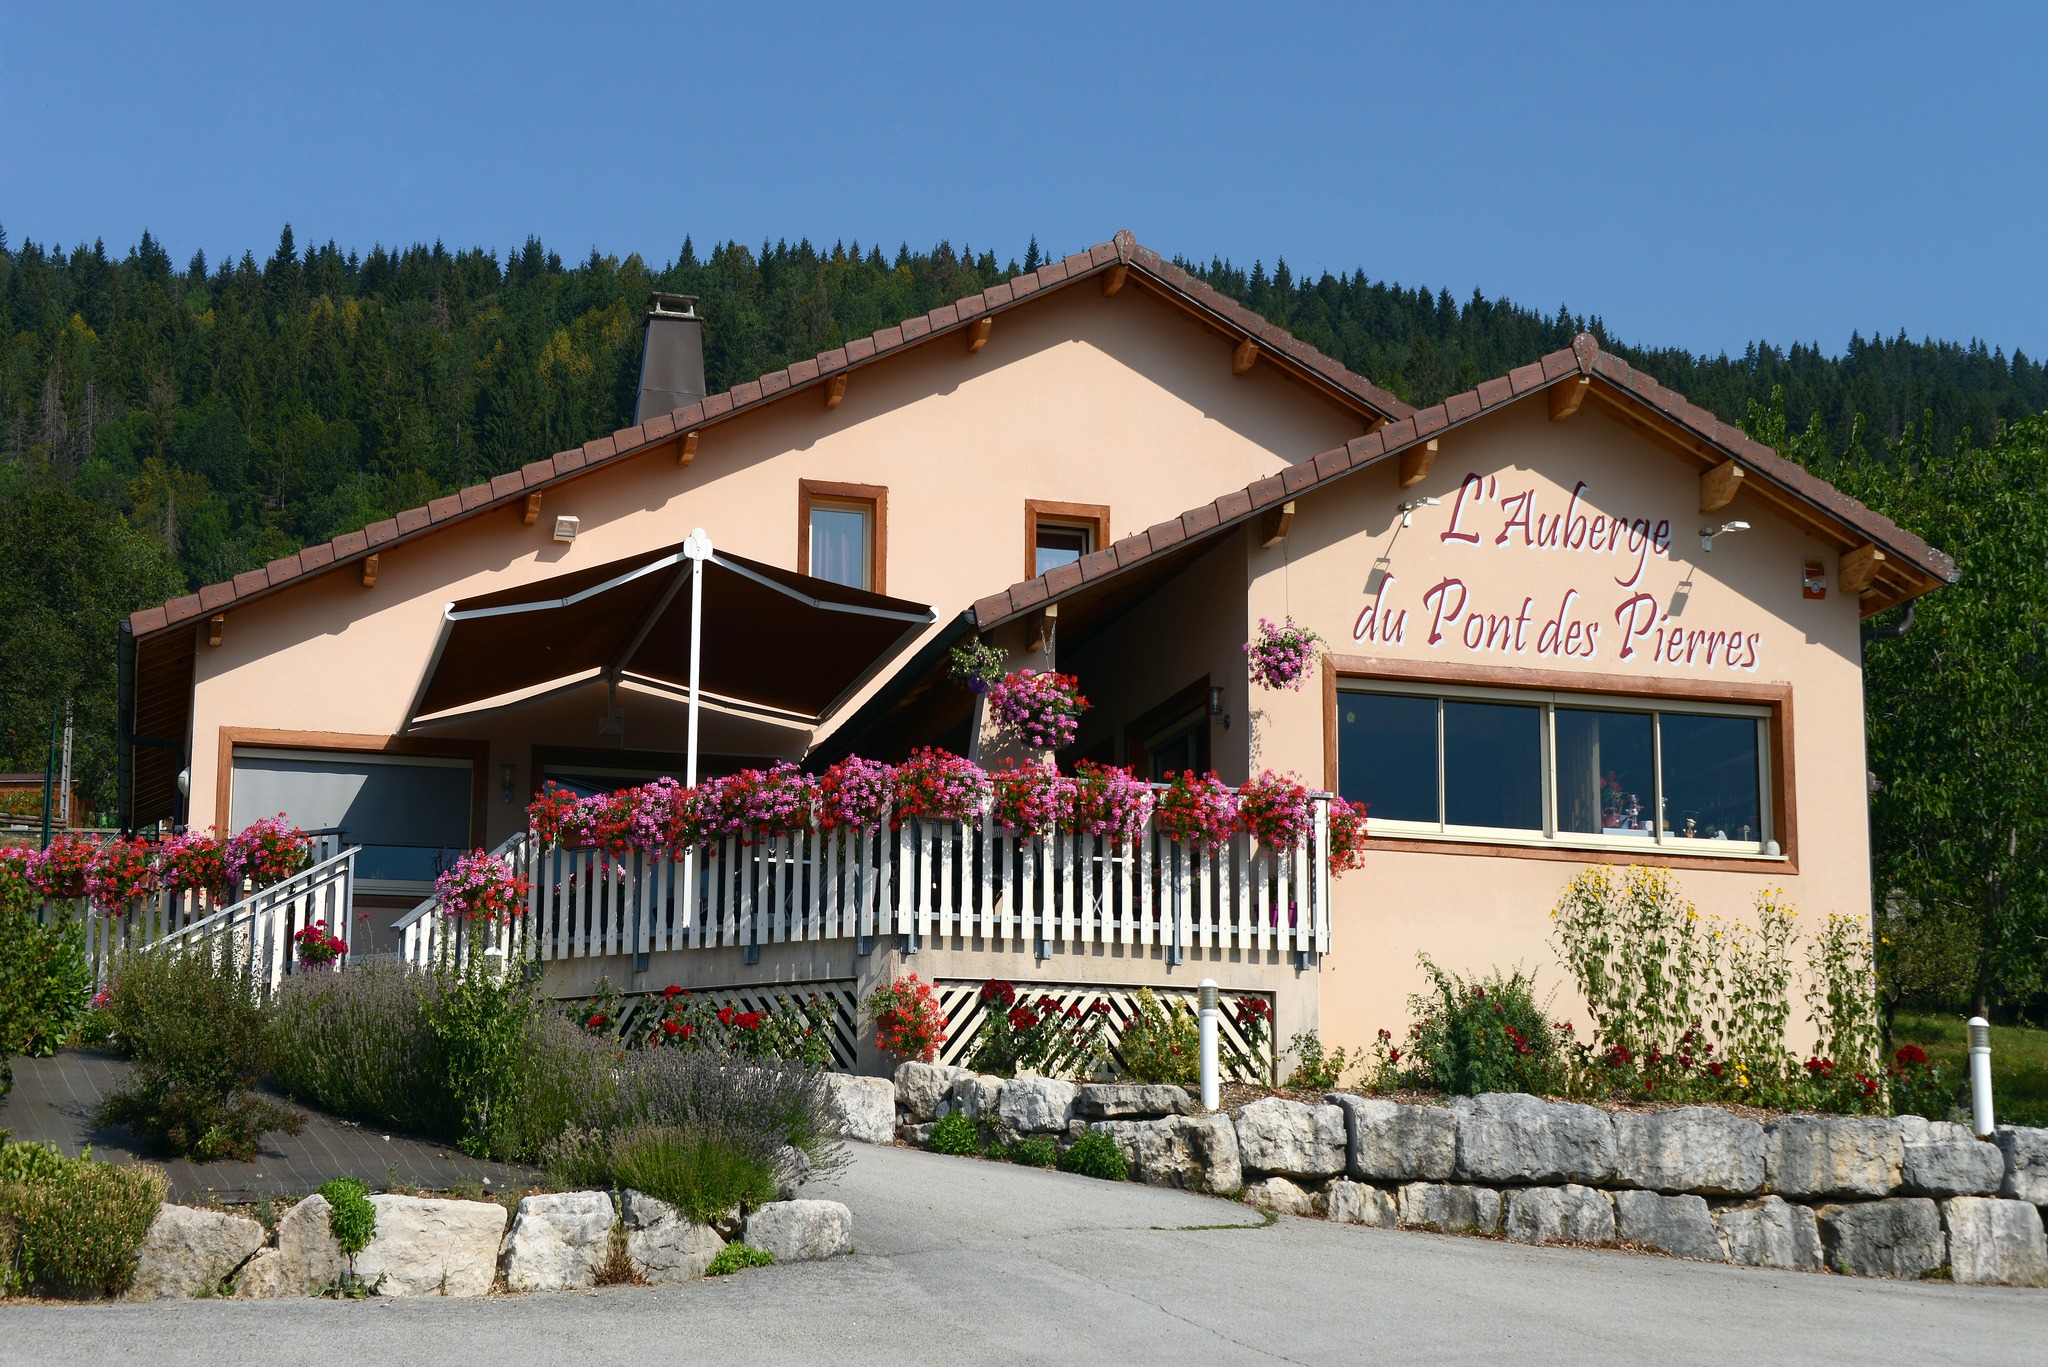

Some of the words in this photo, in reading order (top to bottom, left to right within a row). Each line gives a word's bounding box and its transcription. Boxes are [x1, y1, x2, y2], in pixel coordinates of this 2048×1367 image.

[1440, 472, 1672, 588] L'Auberge
[1352, 572, 1407, 645] du
[1423, 576, 1533, 650] Pont
[1537, 588, 1600, 658] des
[1614, 591, 1762, 671] Pierres
